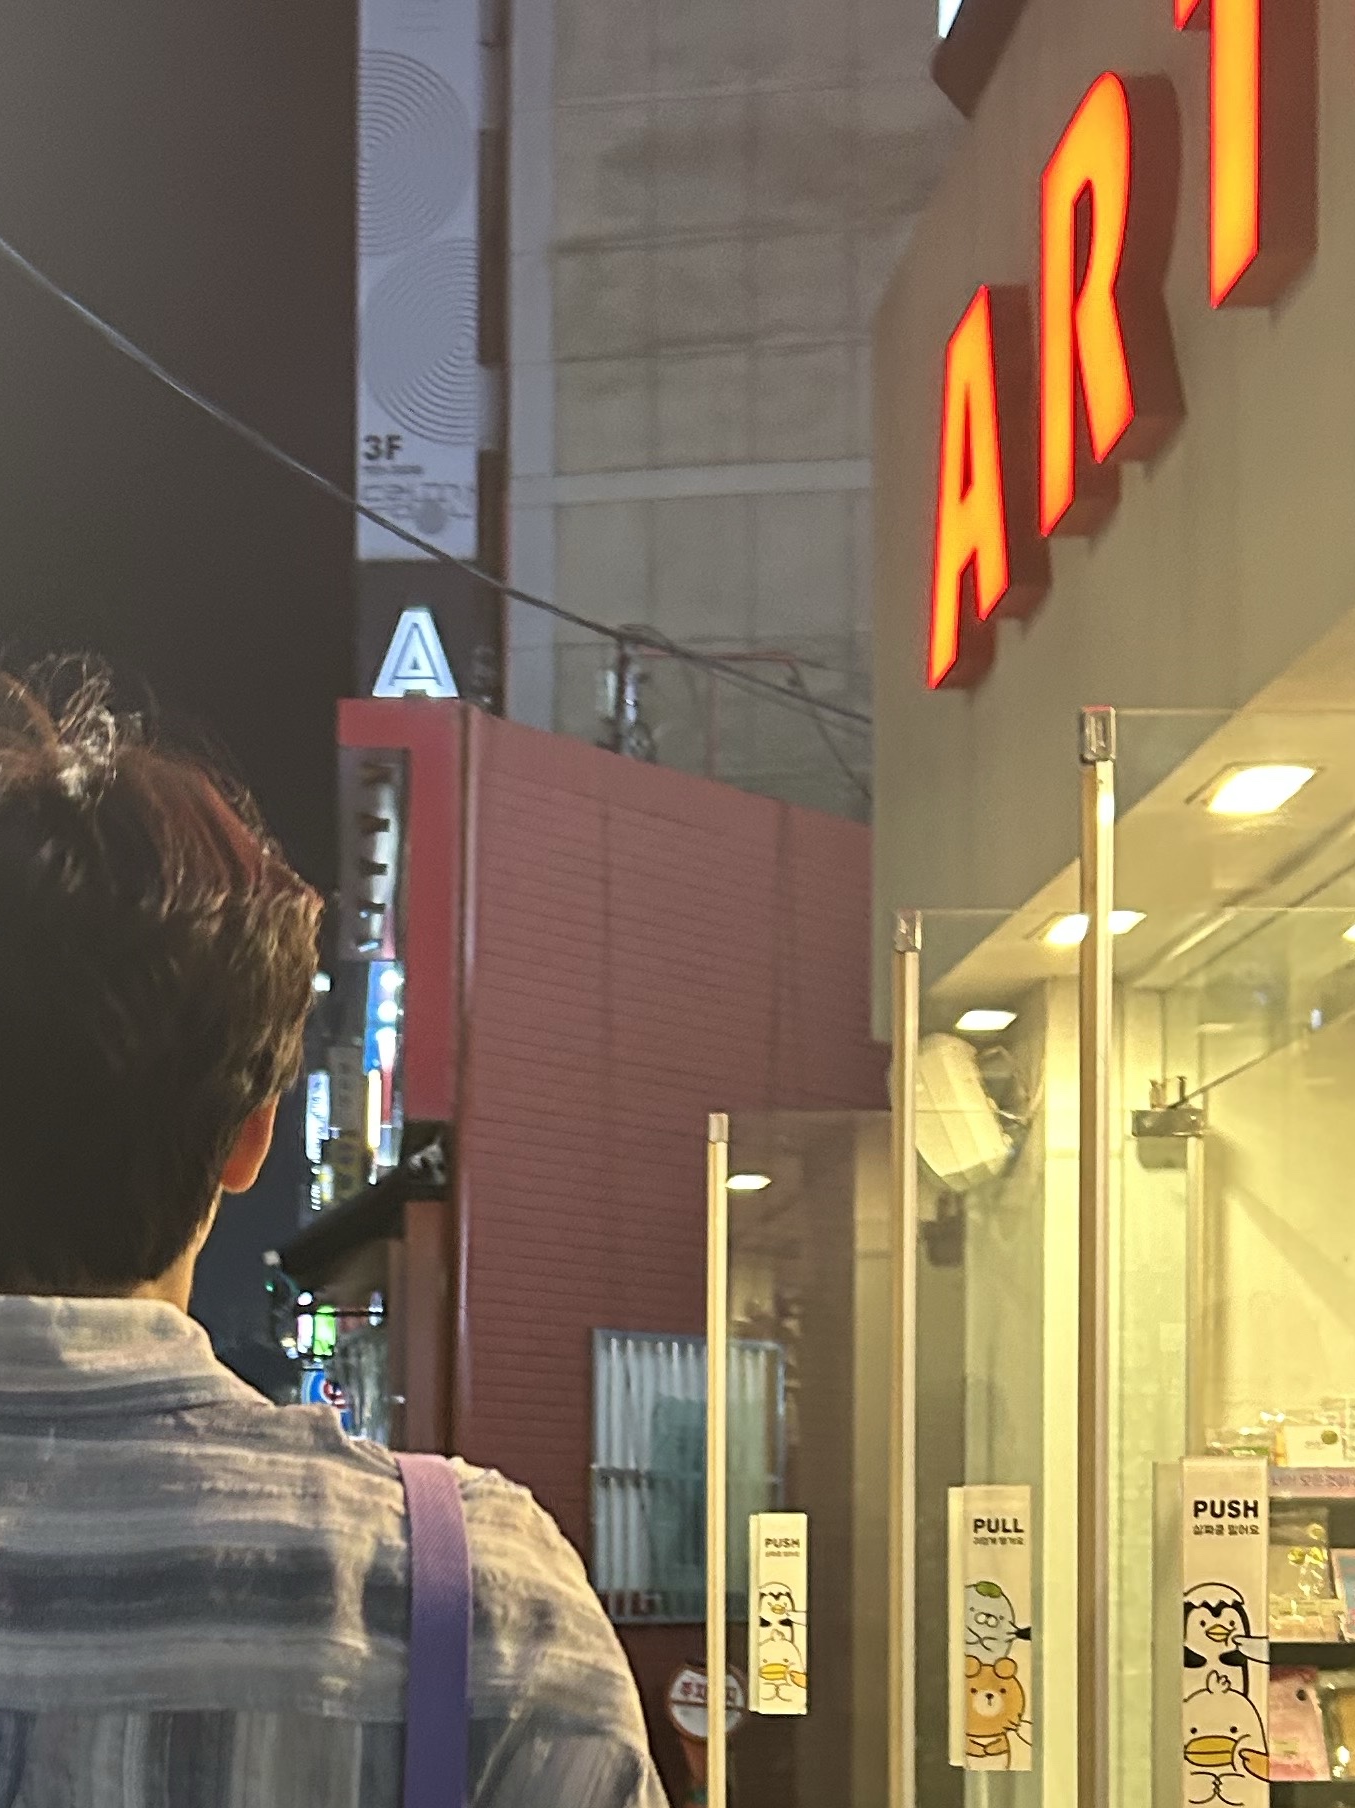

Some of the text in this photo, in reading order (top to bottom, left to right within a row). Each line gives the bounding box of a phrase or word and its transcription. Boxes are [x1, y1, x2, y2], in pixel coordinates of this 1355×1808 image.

[363, 434, 402, 461] 3F
[372, 609, 458, 698] A
[1193, 1500, 1259, 1518] PUSH
[973, 1518, 1025, 1534] PULL
[764, 1537, 800, 1549] PUSH
